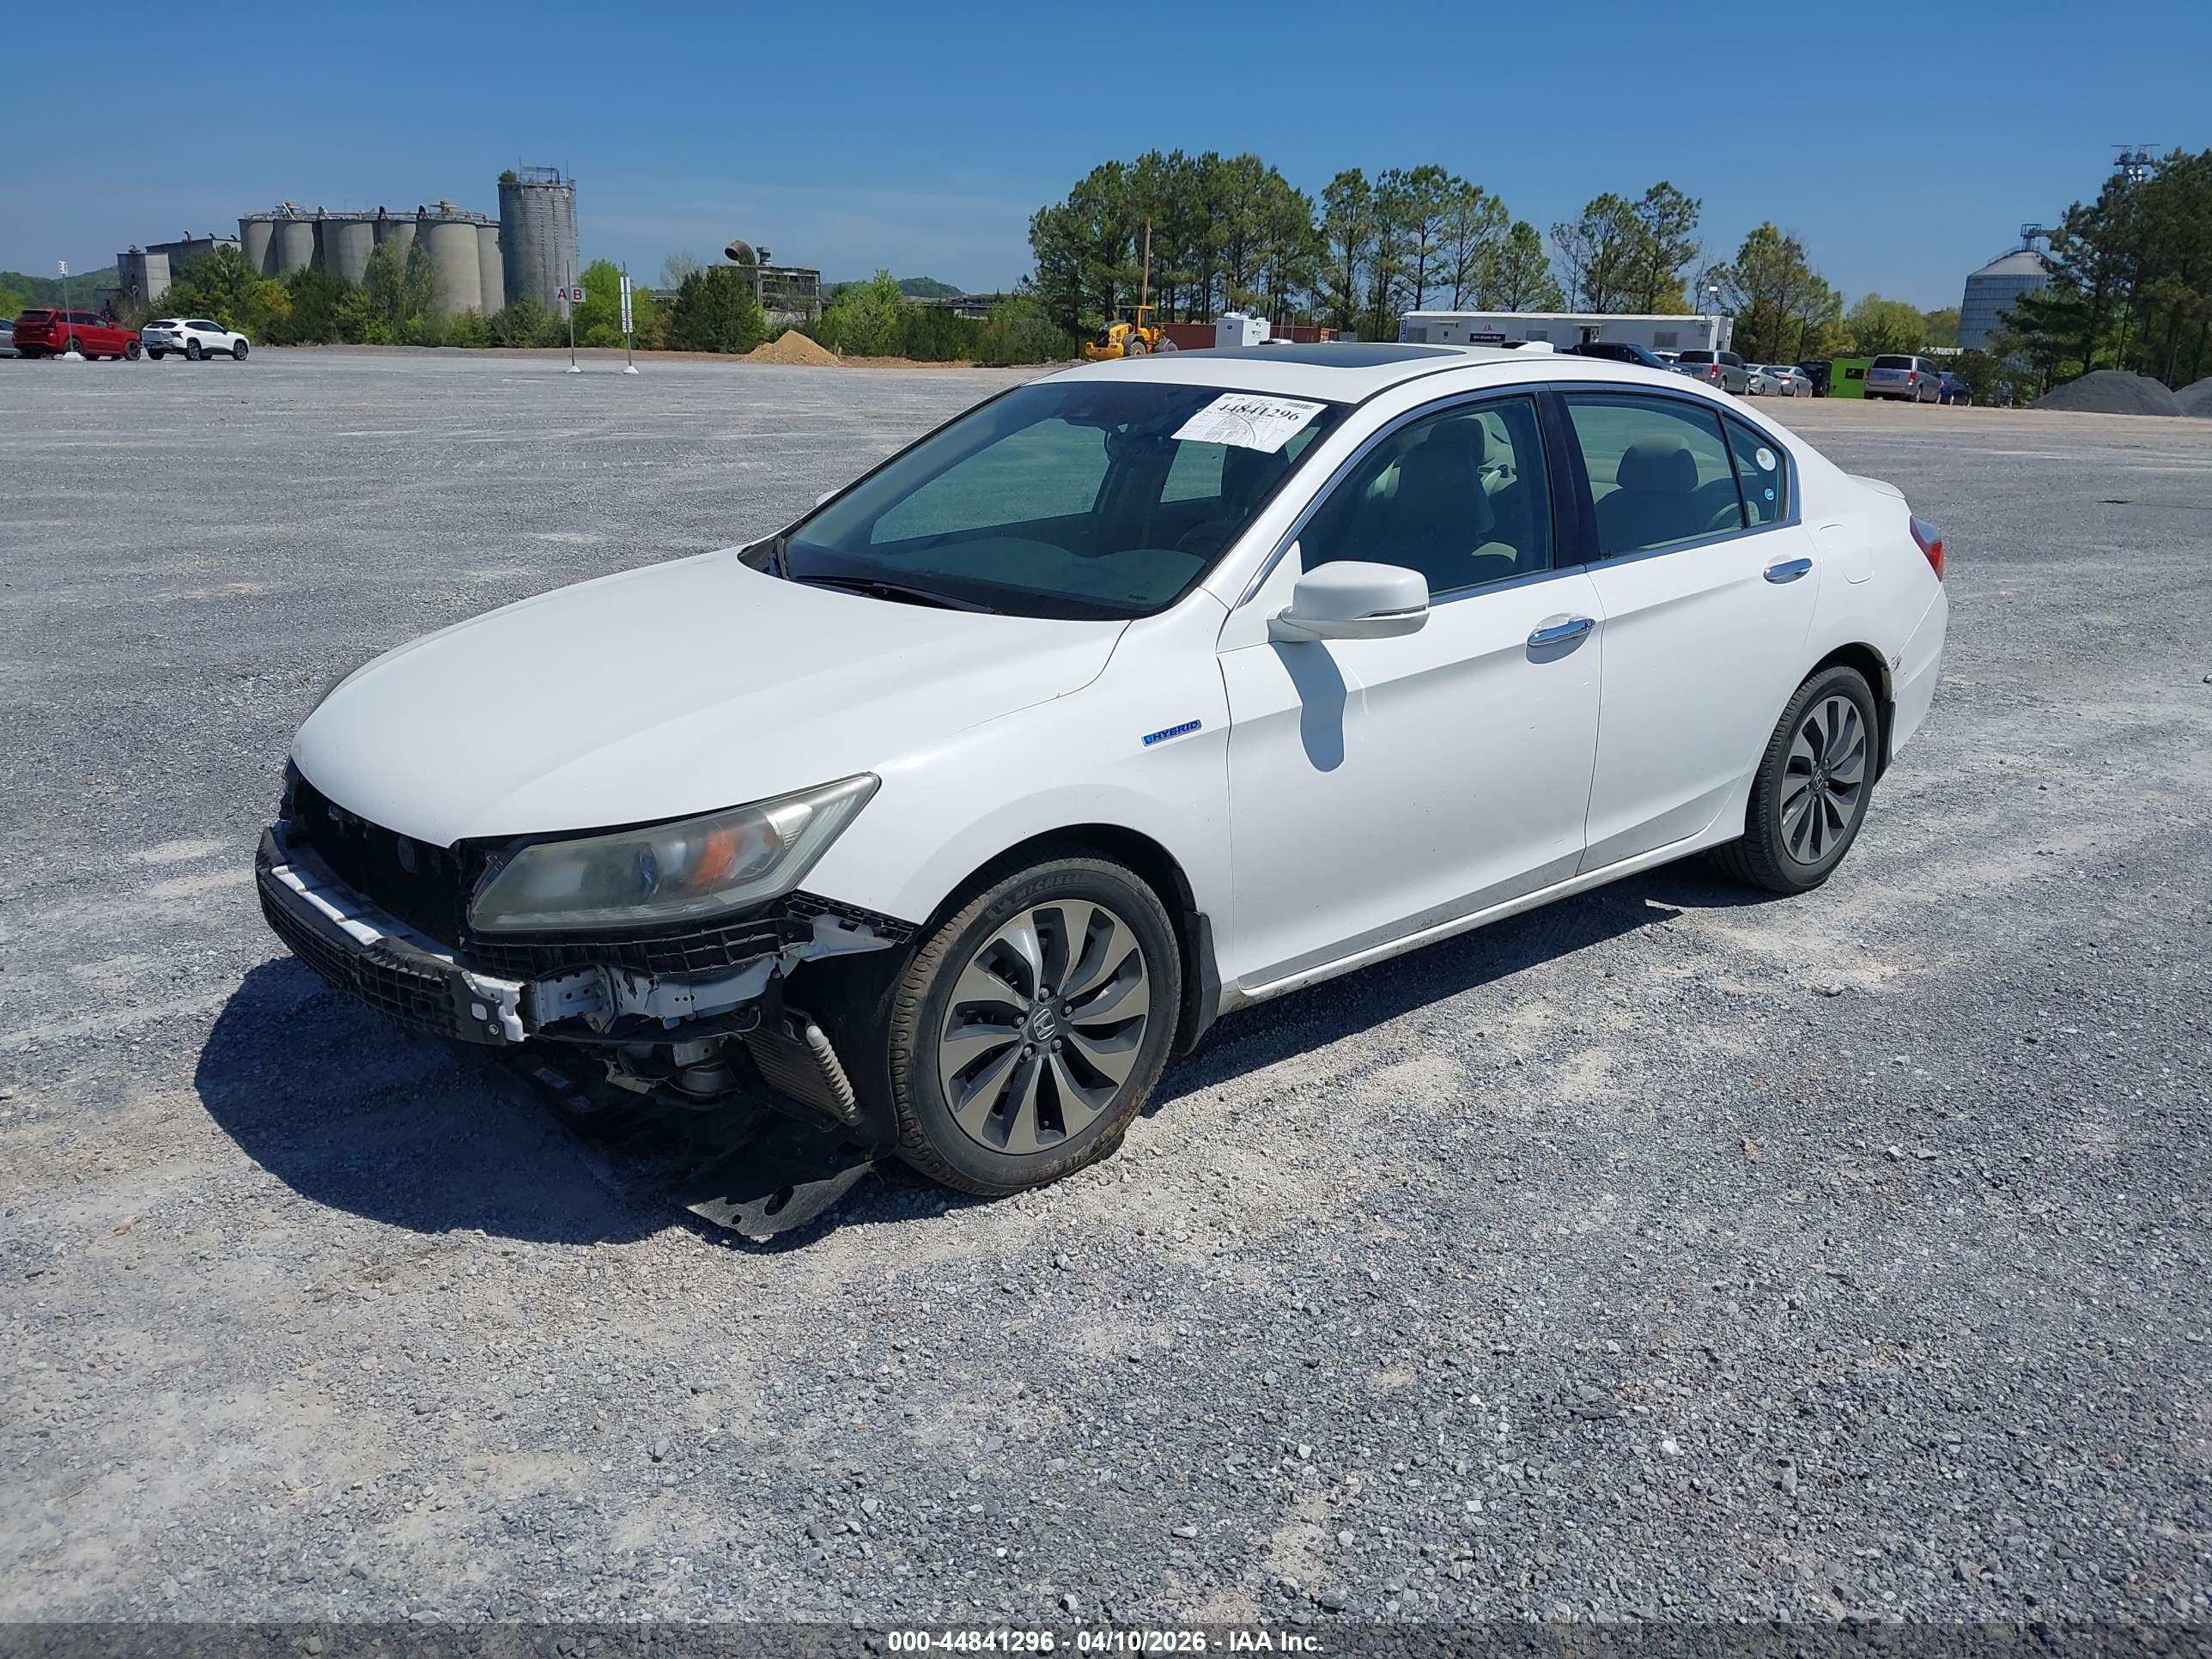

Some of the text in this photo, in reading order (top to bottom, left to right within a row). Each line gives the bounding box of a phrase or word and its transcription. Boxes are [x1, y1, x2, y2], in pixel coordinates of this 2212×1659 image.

[557, 288, 568, 300] A
[573, 289, 582, 301] B
[1218, 403, 1299, 422] 44841296
[1152, 720, 1200, 742] HYBRID
